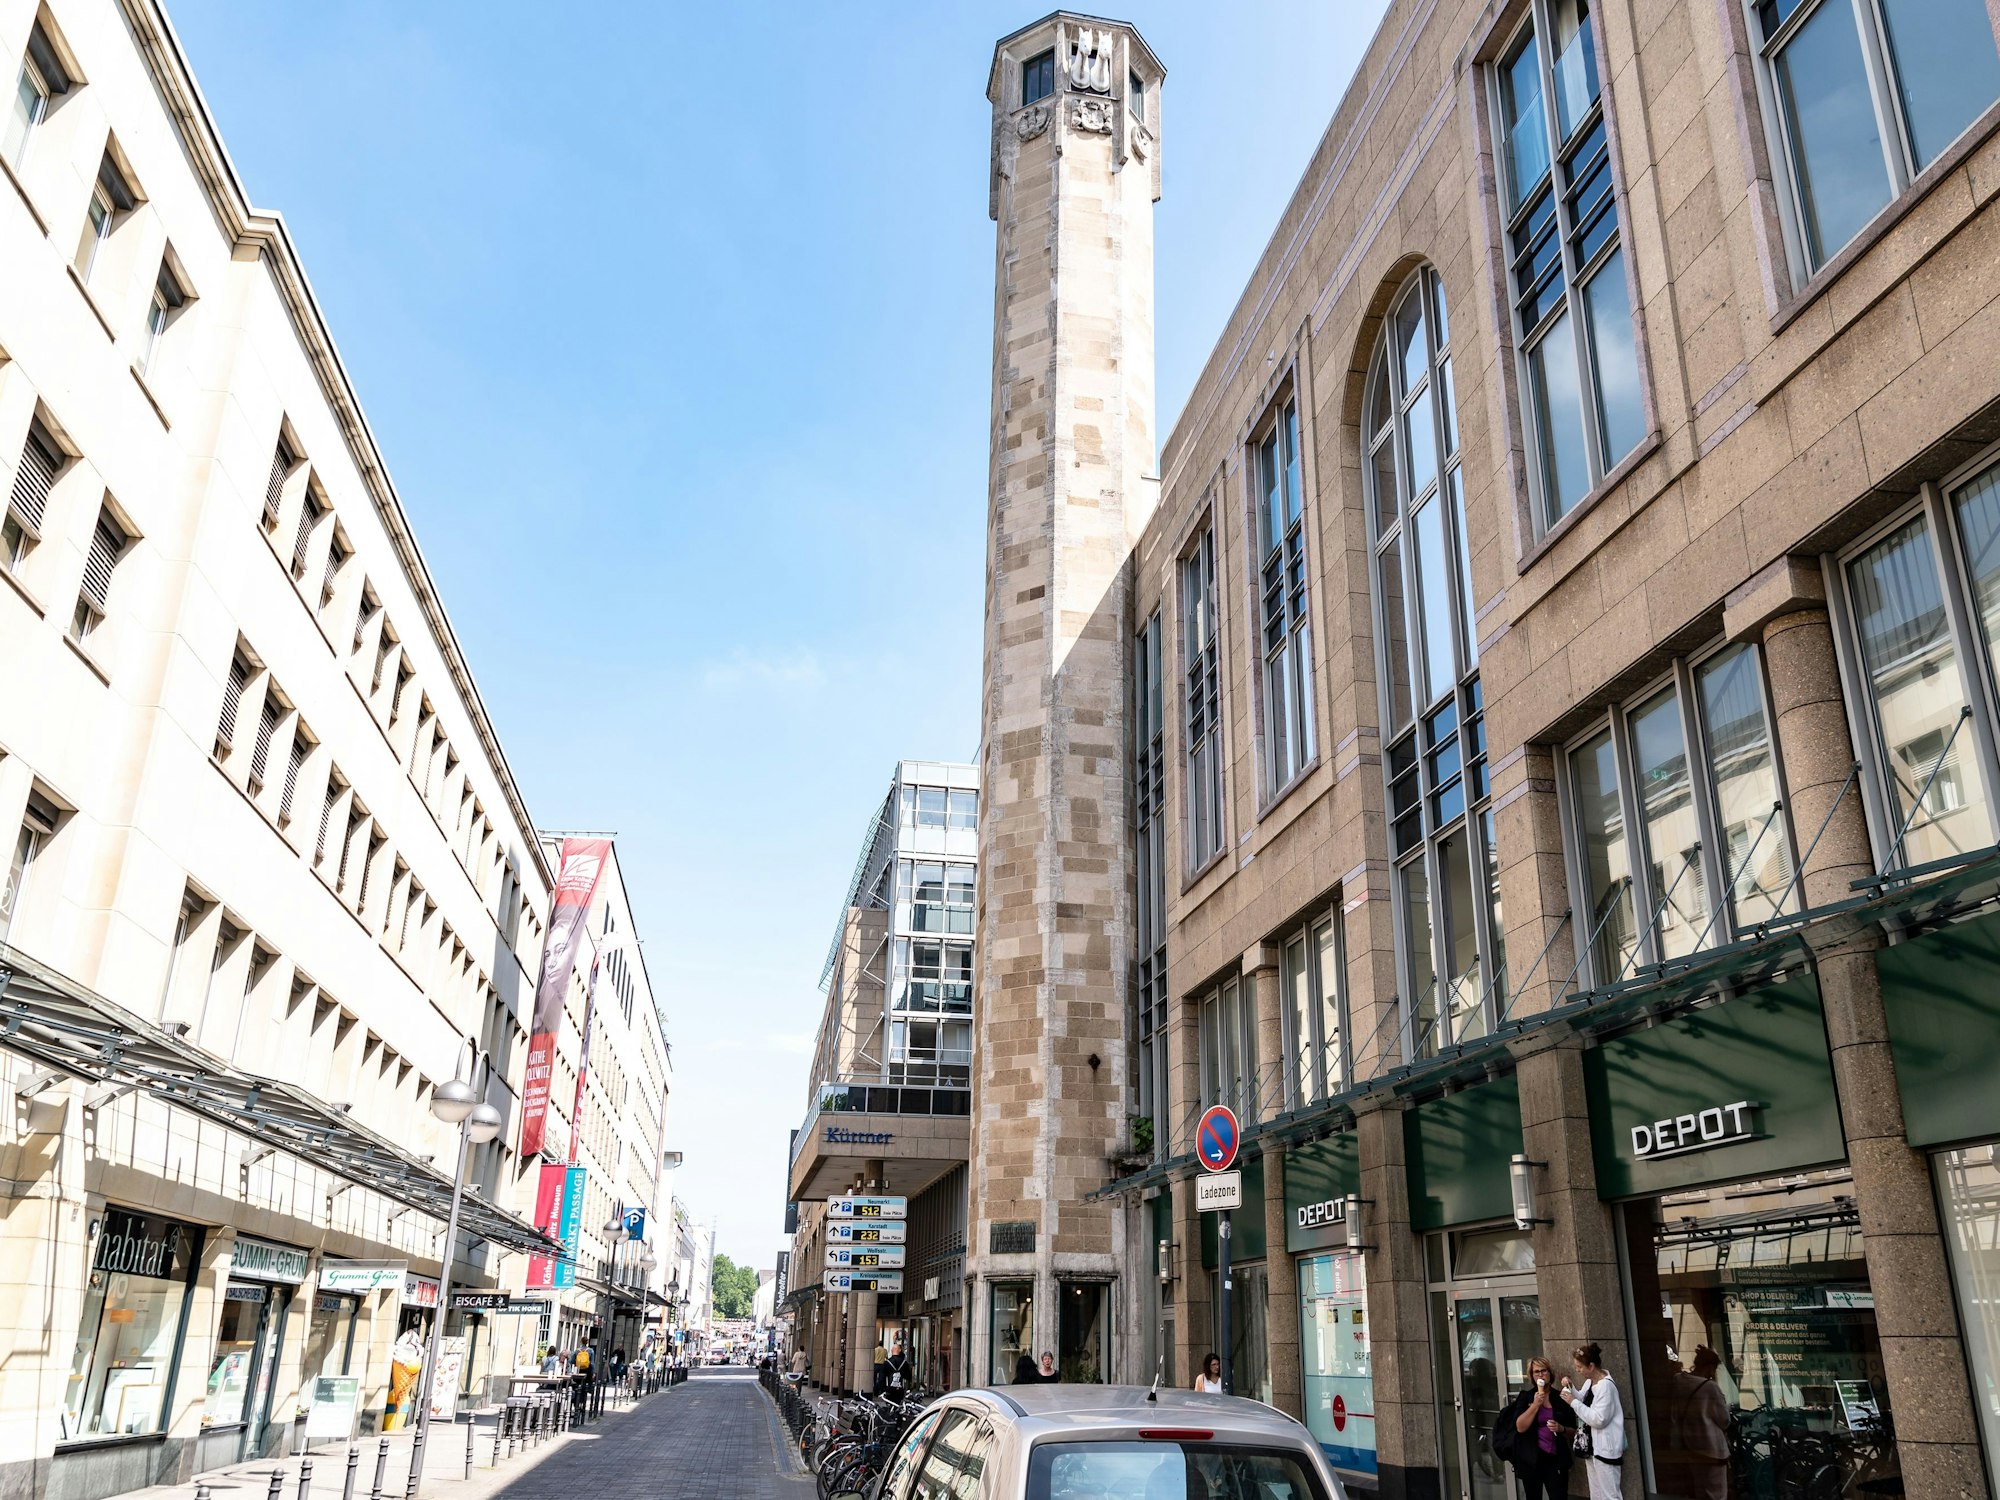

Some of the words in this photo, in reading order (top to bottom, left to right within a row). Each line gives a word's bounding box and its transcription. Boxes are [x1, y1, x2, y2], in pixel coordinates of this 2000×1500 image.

[1631, 1101, 1748, 1155] DEPOT
[570, 1172, 584, 1219] PASSAGE
[1200, 1185, 1236, 1199] Ladezone
[550, 1184, 562, 1219] Museum
[861, 1206, 879, 1216] 512
[1298, 1197, 1344, 1226] DEPOT
[860, 1230, 878, 1240] 232
[93, 1212, 168, 1276] habitat
[231, 1240, 308, 1277] GUMMI-GRÜN
[859, 1255, 878, 1265] 153
[870, 1281, 876, 1290] 0
[455, 1295, 493, 1306] EISCAFÉ
[1766, 1292, 1799, 1300] DELIVERY
